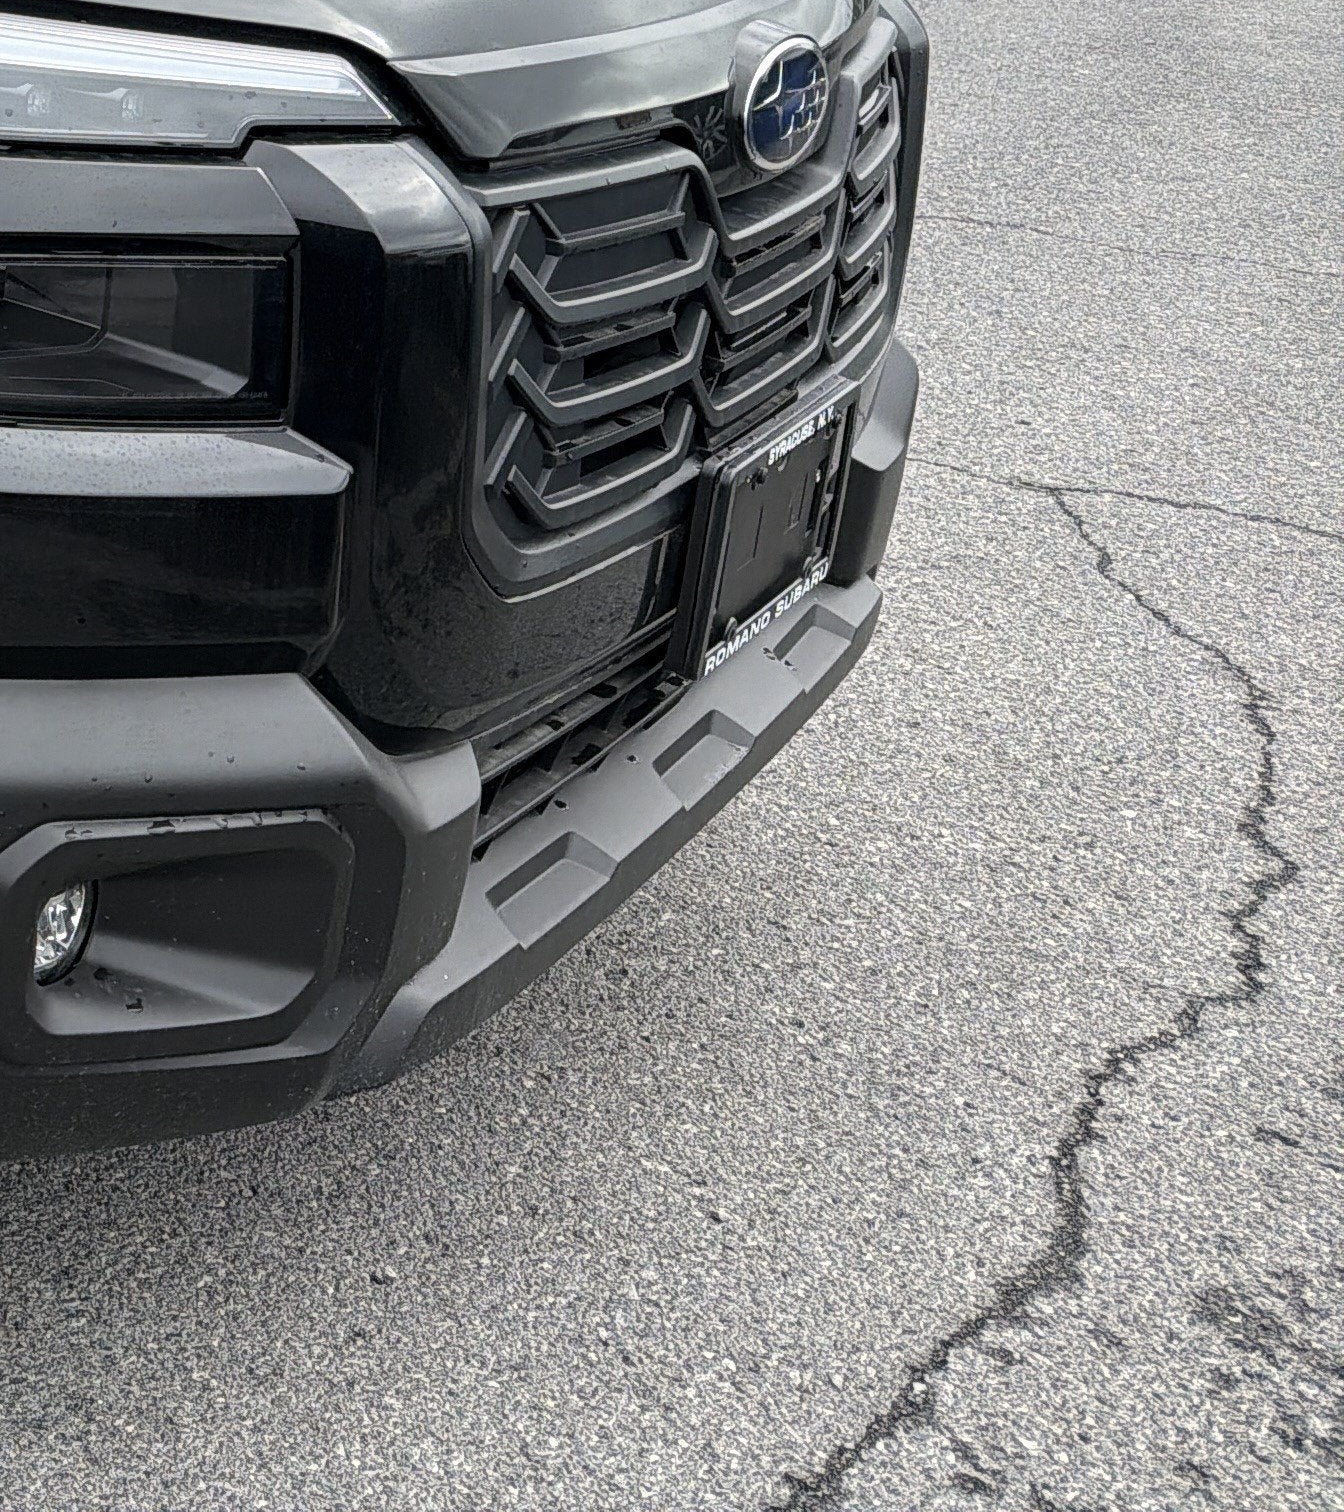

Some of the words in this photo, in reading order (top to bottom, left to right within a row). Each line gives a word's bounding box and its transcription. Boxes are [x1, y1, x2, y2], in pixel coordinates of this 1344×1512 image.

[768, 419, 815, 466] SYRACUSE
[704, 610, 771, 677] ROMANO
[774, 562, 829, 618] SUBARU
